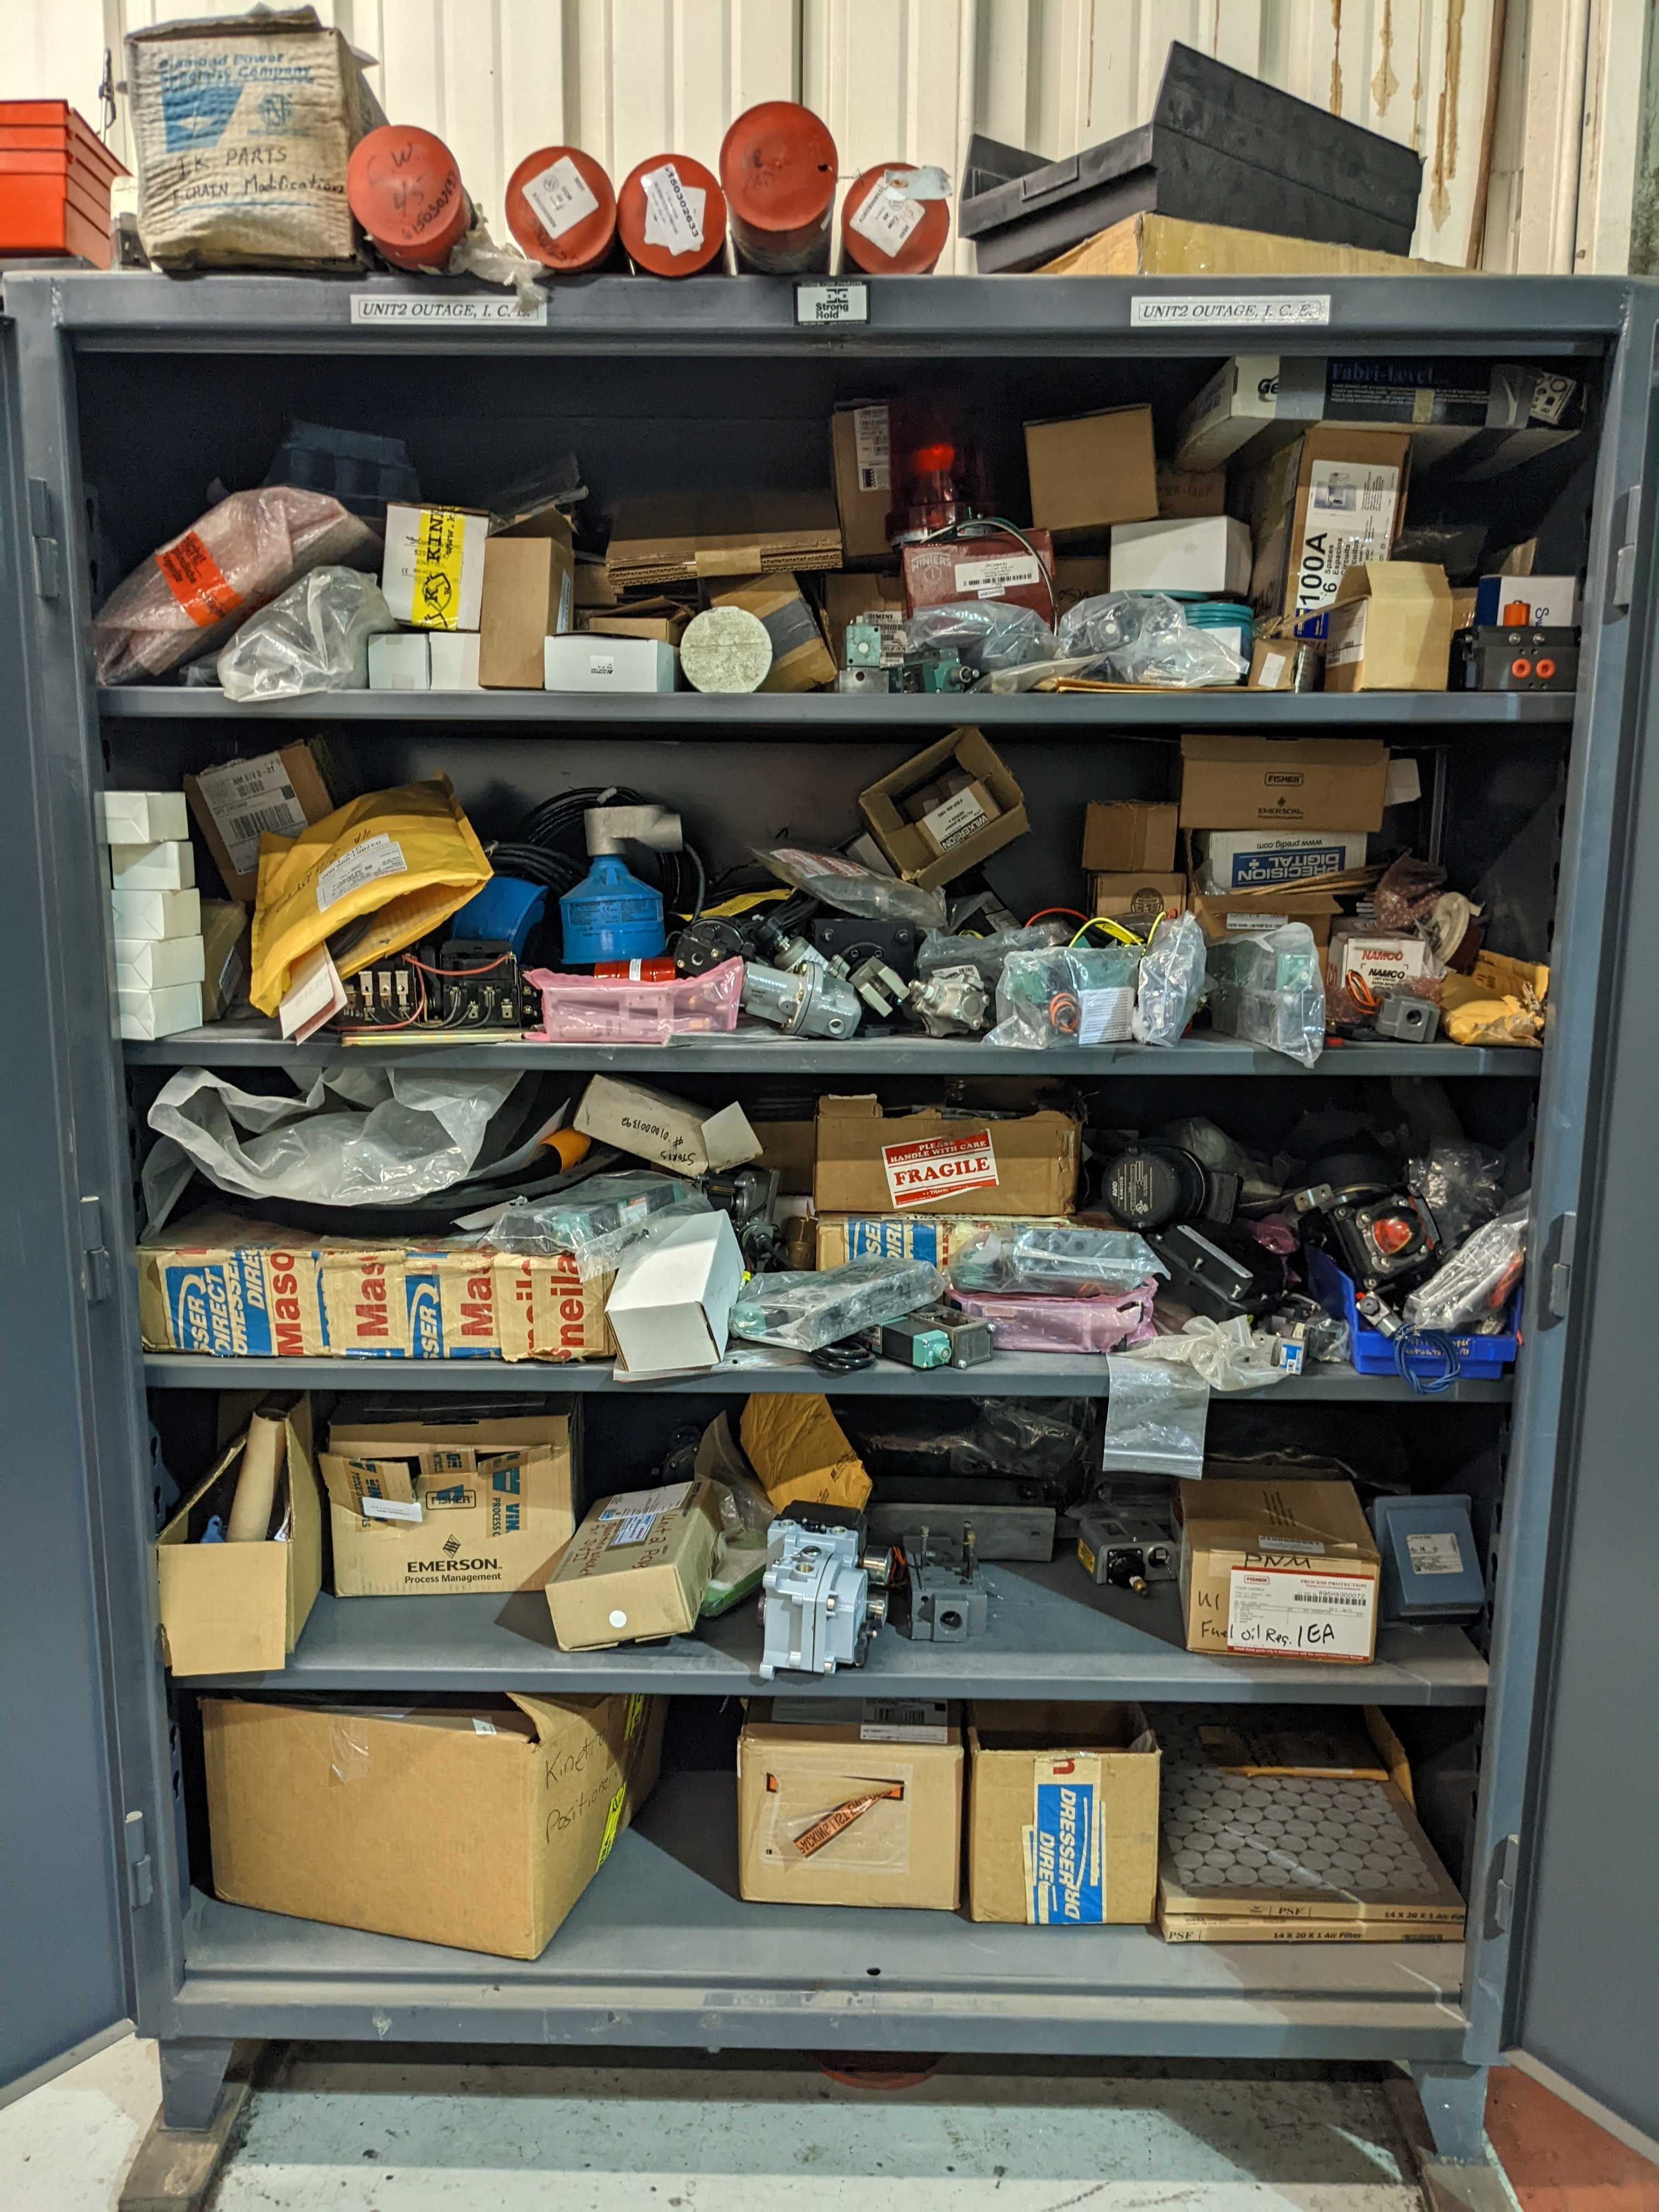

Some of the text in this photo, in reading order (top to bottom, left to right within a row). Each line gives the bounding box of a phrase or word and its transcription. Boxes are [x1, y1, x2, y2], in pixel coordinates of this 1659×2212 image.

[233, 53, 284, 66] Power
[225, 146, 287, 167] PARTS
[244, 173, 345, 195] Modification
[362, 302, 408, 316] UNIT2
[411, 303, 478, 319] OUTAGE,
[497, 304, 512, 318] C.
[815, 301, 849, 312] Strong
[1143, 304, 1188, 318] UNIT2
[1192, 304, 1259, 318] OUTAGE,
[815, 311, 839, 319] Hold
[426, 512, 444, 563] KIN
[1324, 544, 1335, 574] Spaces
[1333, 537, 1343, 576] Espacios
[1299, 532, 1328, 606] 100A
[1322, 581, 1338, 594] 6
[1268, 775, 1300, 783] FISHER
[1258, 808, 1300, 816] EMERSON
[941, 812, 990, 851] WILKERSON
[1256, 839, 1323, 849] www.predig.com
[1267, 851, 1340, 867] DIGITAL
[1362, 950, 1404, 962] NAMCO
[1368, 968, 1406, 979] NAMCO
[659, 1150, 696, 1166] STORES
[889, 1139, 988, 1164] HANDLE WITH CARE
[893, 1156, 991, 1187] FRAGILE
[269, 1251, 304, 1356] Maso
[431, 1494, 473, 1505] FISHER
[492, 1497, 501, 1529] PROCESS
[407, 1558, 499, 1573] EMERSON
[1244, 1553, 1312, 1570] PNM
[404, 1571, 502, 1584] Process Management
[1335, 1580, 1368, 1589] PROTECTION
[1201, 1618, 1234, 1640] Fuel
[1057, 1787, 1076, 1885] DRESSER
[1278, 1906, 1304, 1916] PSF
[1168, 1931, 1194, 1940] PSF
[1340, 1931, 1363, 1939] Filter
